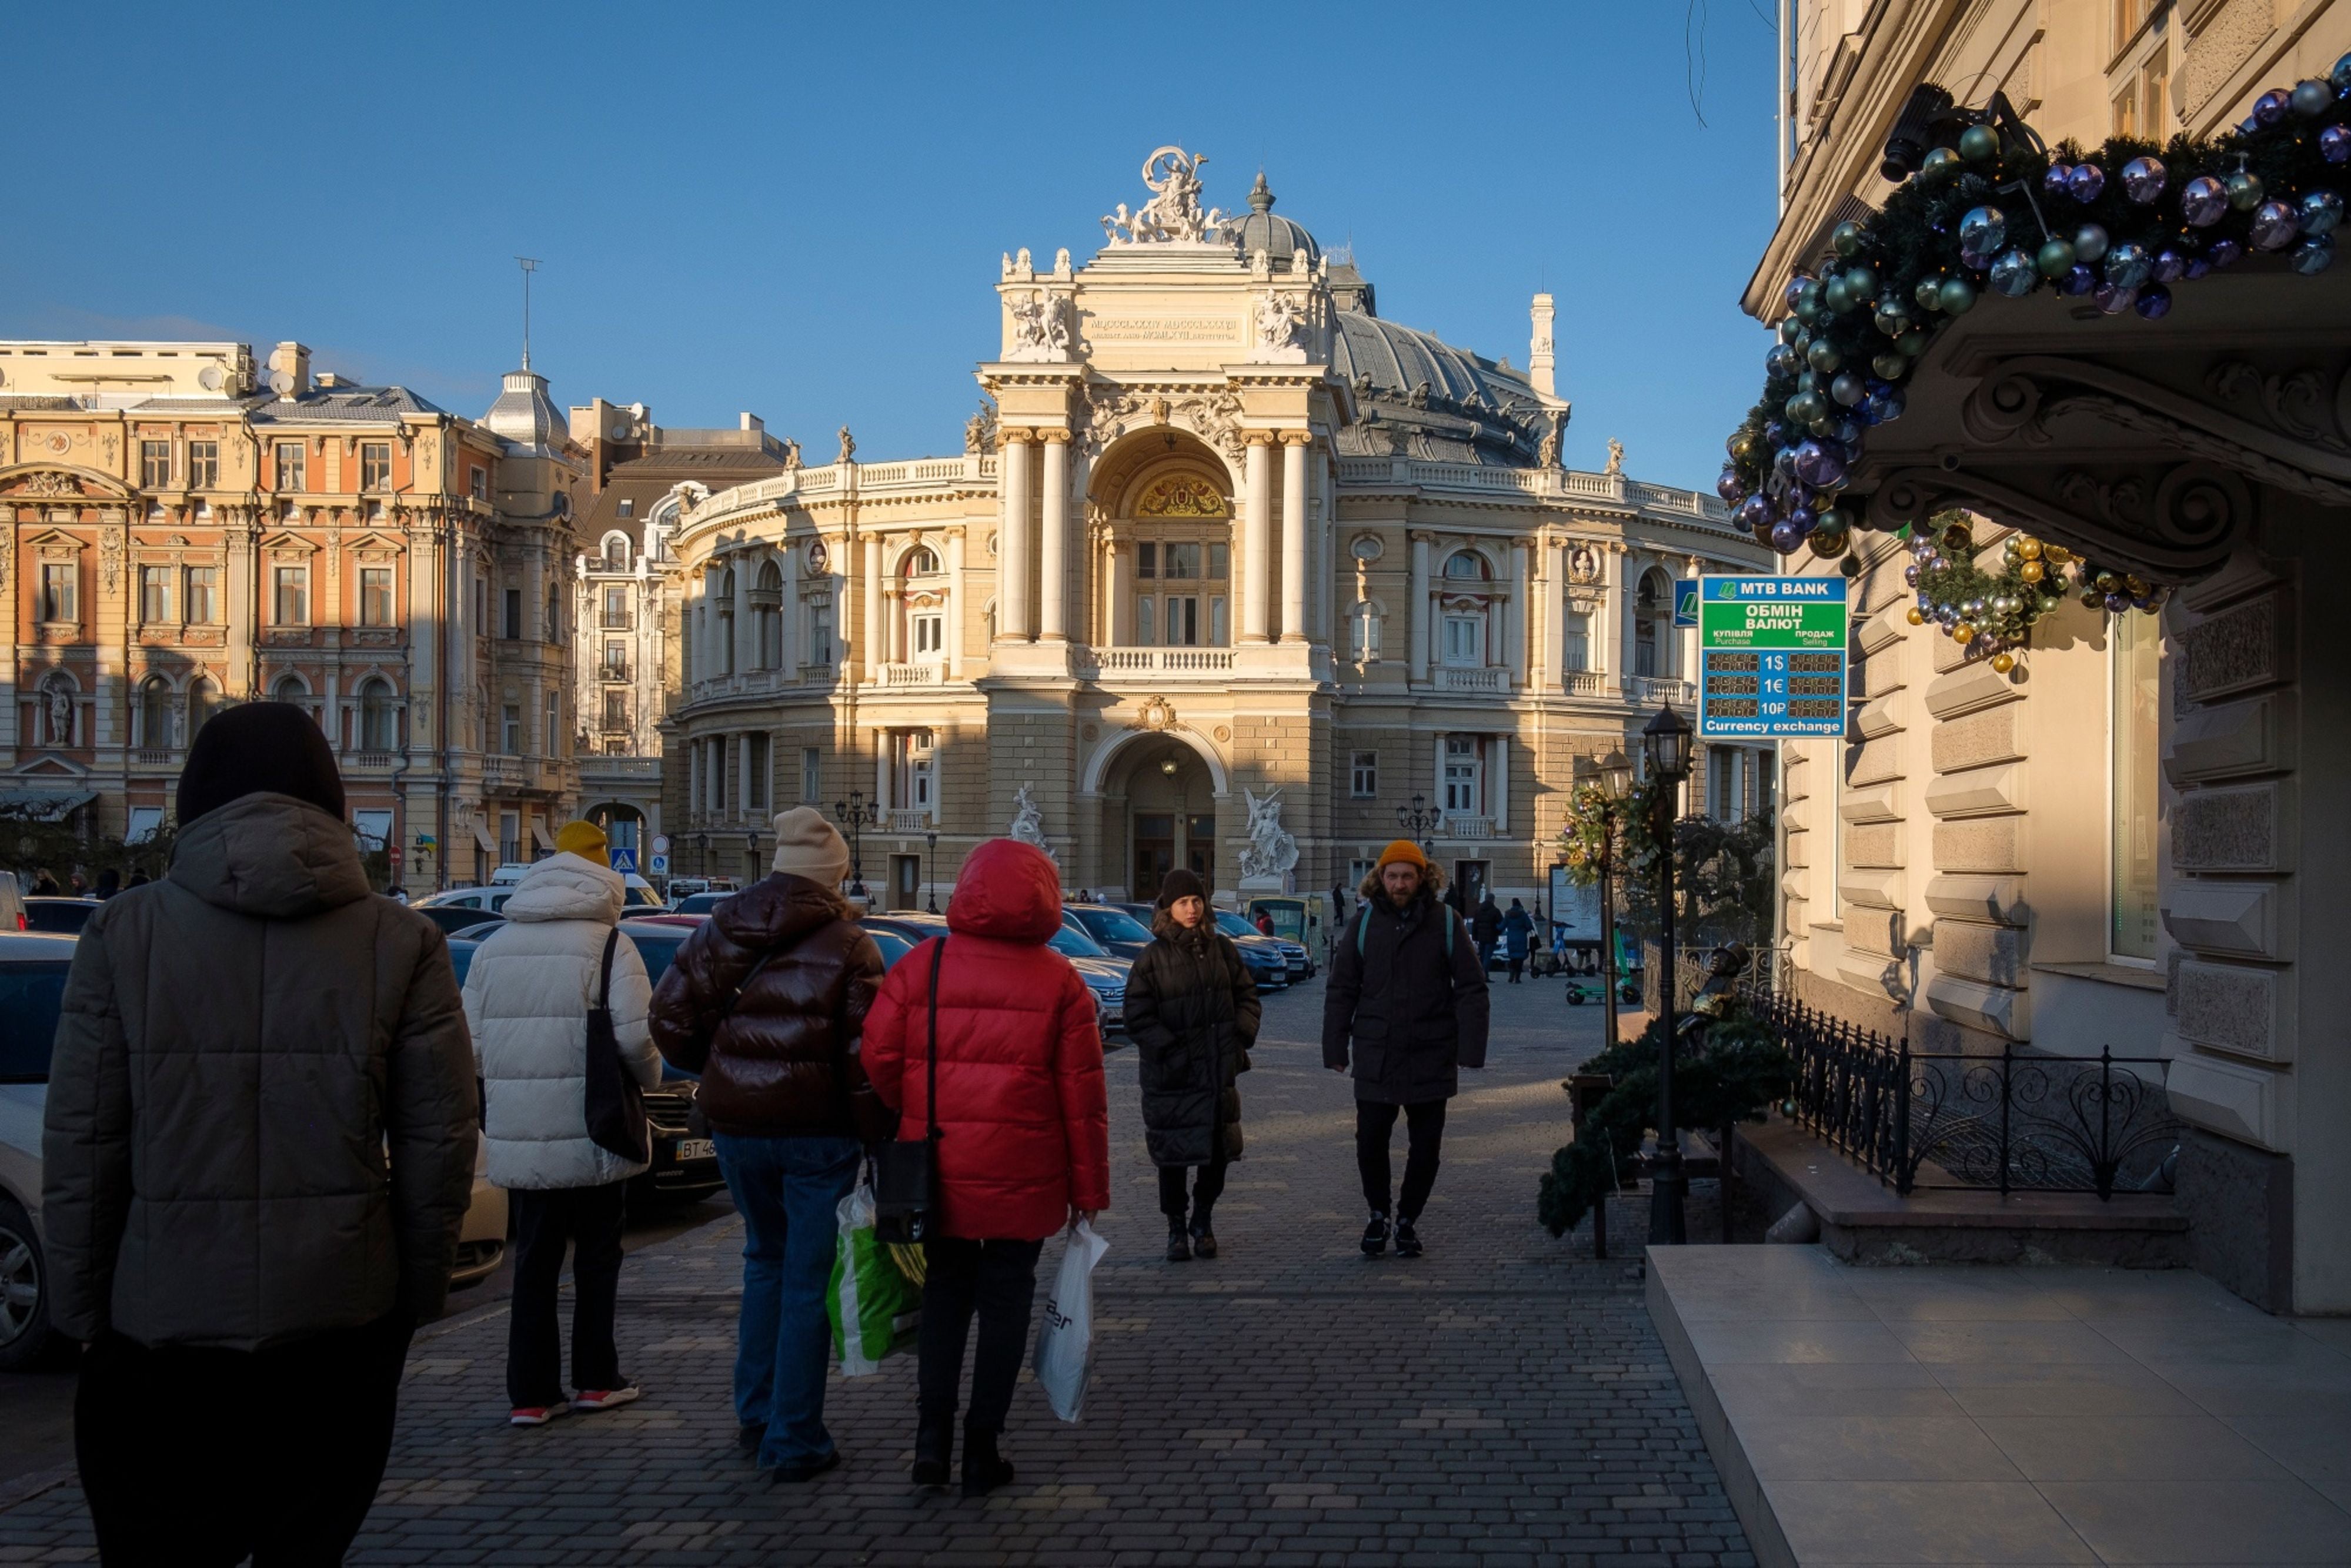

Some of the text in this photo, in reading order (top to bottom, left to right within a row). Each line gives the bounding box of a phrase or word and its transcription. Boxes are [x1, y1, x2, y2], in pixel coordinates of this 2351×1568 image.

[1741, 583, 1829, 595] MTB BANK
[1746, 605, 1803, 617] ОБМІН
[1745, 618, 1802, 630] ВАЛЮТ
[1802, 638, 1828, 646] Selling
[1765, 655, 1784, 671] 1$
[1764, 678, 1784, 693] 1€
[1706, 720, 1840, 733] Currency exchange
[684, 1142, 700, 1157] BT
